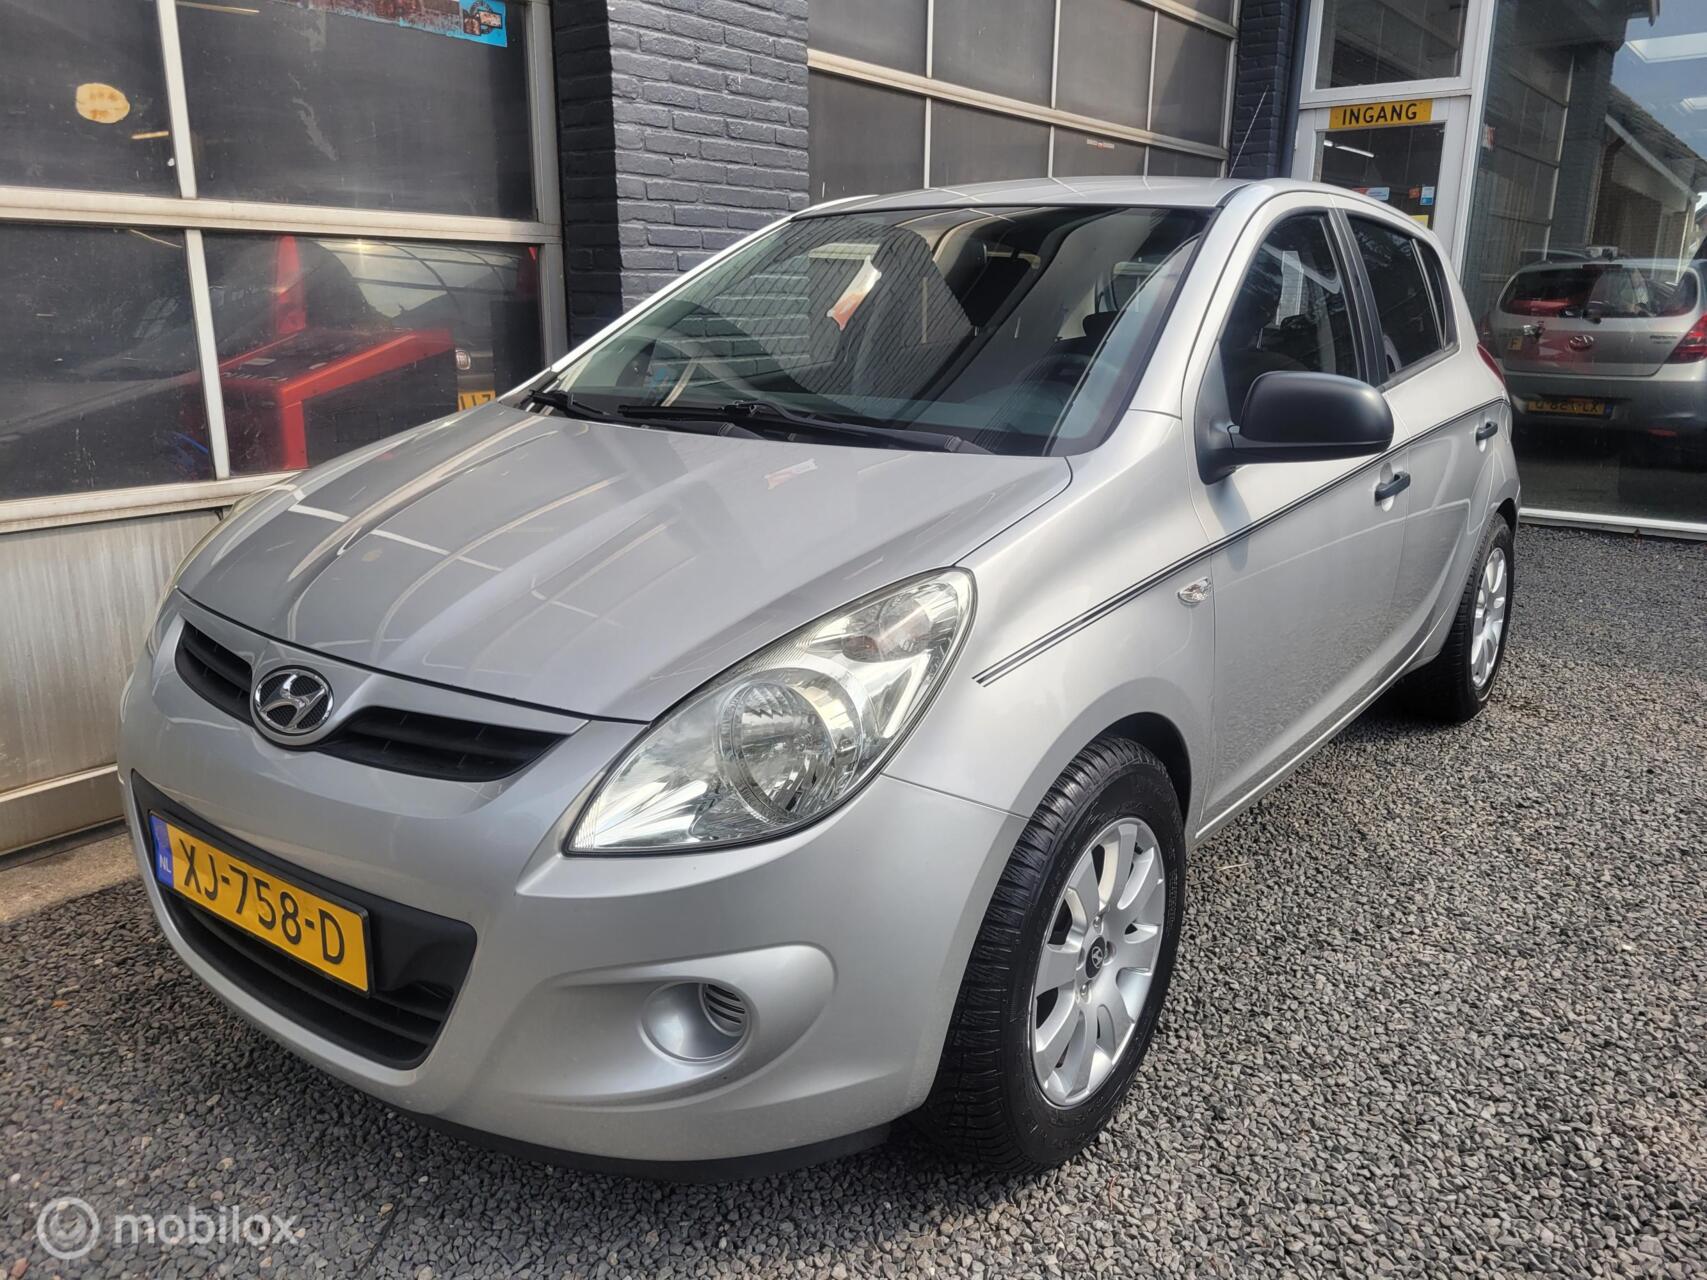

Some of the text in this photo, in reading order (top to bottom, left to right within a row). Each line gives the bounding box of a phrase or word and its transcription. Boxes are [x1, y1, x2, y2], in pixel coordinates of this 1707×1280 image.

[1342, 103, 1418, 125] INGANG
[159, 854, 172, 874] NL
[178, 838, 345, 966] XJ-758-D
